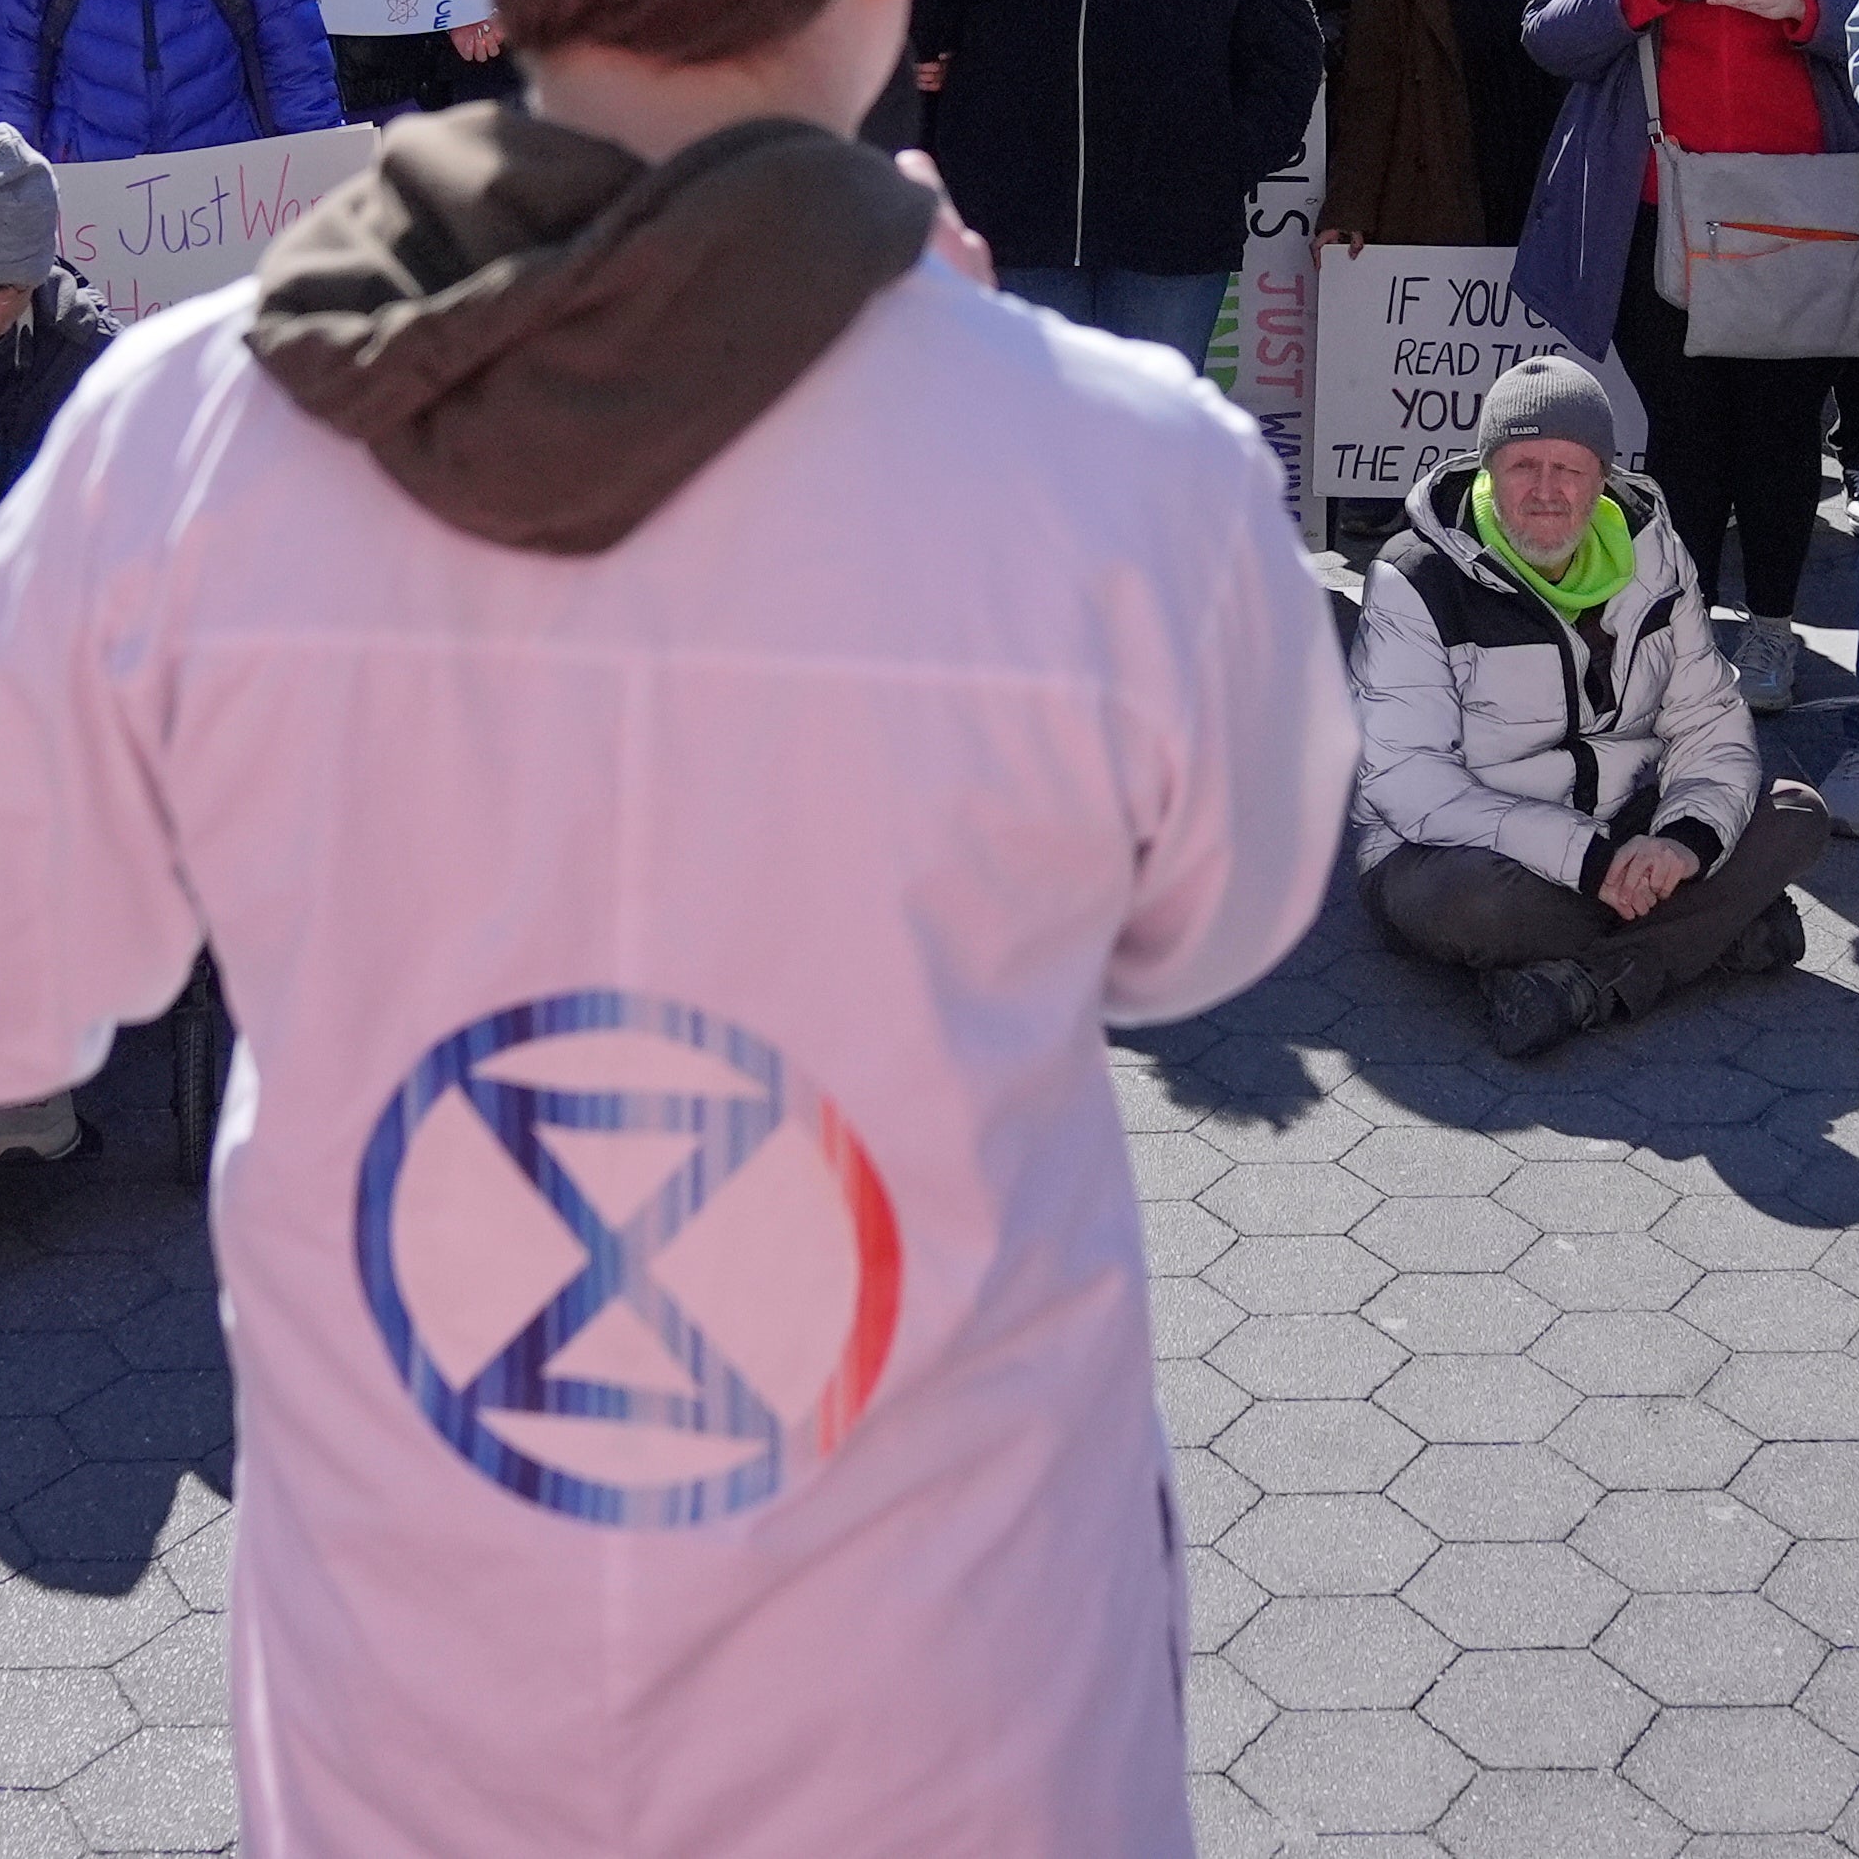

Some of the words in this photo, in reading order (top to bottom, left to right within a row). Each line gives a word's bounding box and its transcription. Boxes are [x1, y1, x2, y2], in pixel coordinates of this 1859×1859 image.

[118, 173, 231, 257] Just
[1386, 275, 1430, 325] IF
[1448, 278, 1511, 328] YOU
[1255, 271, 1305, 399] JUST
[1393, 338, 1480, 376] READ
[1392, 388, 1483, 432] YOU
[1331, 444, 1405, 482] THE
